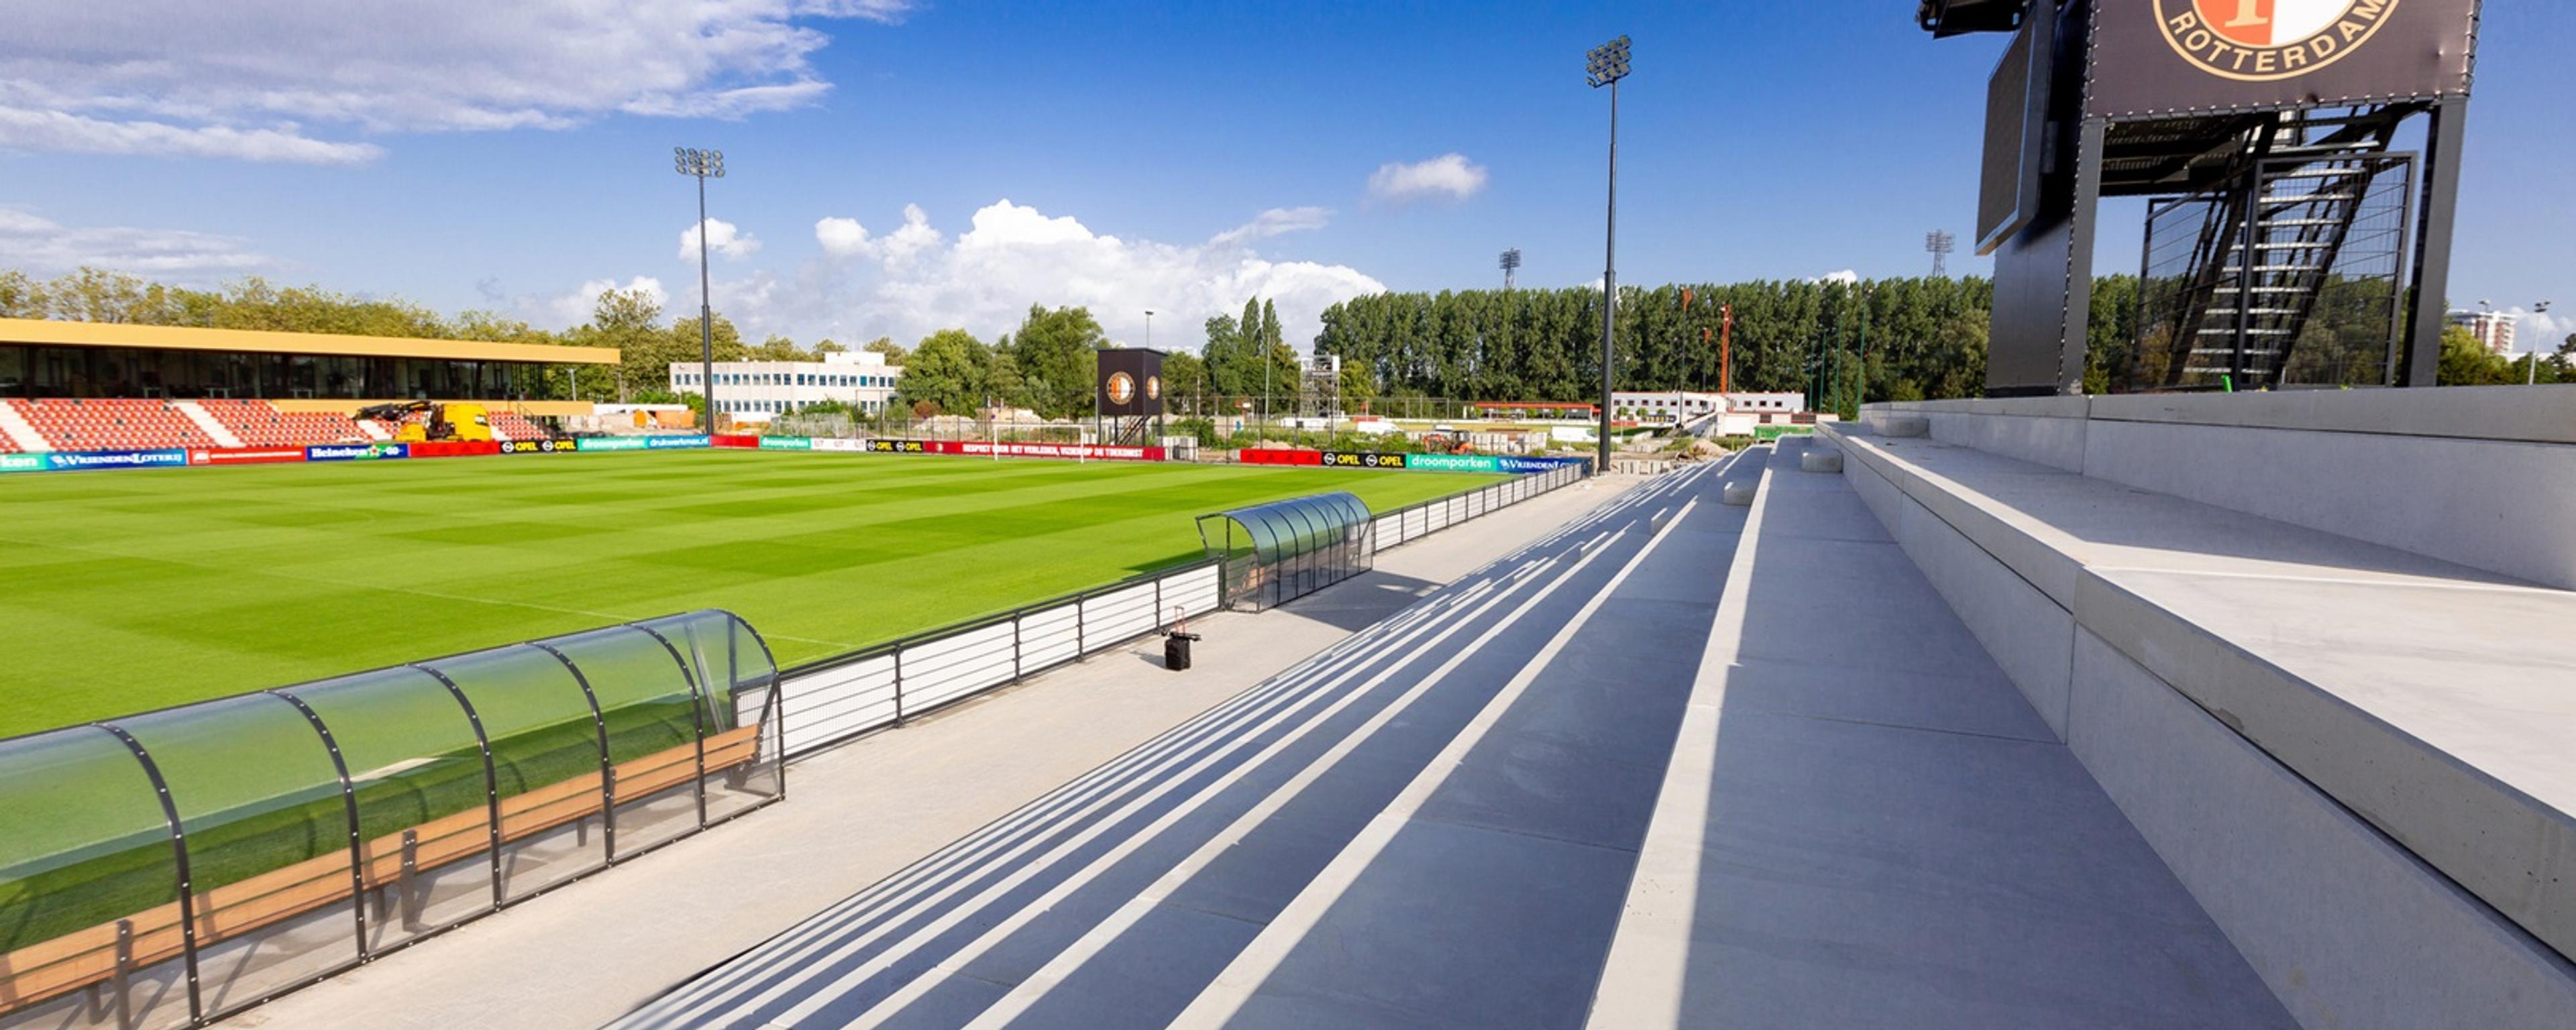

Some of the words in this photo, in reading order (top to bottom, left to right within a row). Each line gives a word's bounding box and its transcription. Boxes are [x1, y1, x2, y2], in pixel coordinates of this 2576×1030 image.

[2169, 0, 2387, 72] ROTTERDAM
[515, 441, 538, 451] OPEL
[554, 440, 576, 450] OPEL
[876, 442, 893, 451] OPEL
[906, 443, 922, 451] OPEL
[311, 447, 367, 457] Heineken
[1337, 454, 1360, 465] OPEL
[1379, 455, 1403, 467] OPEL
[1411, 455, 1491, 469] droomparken
